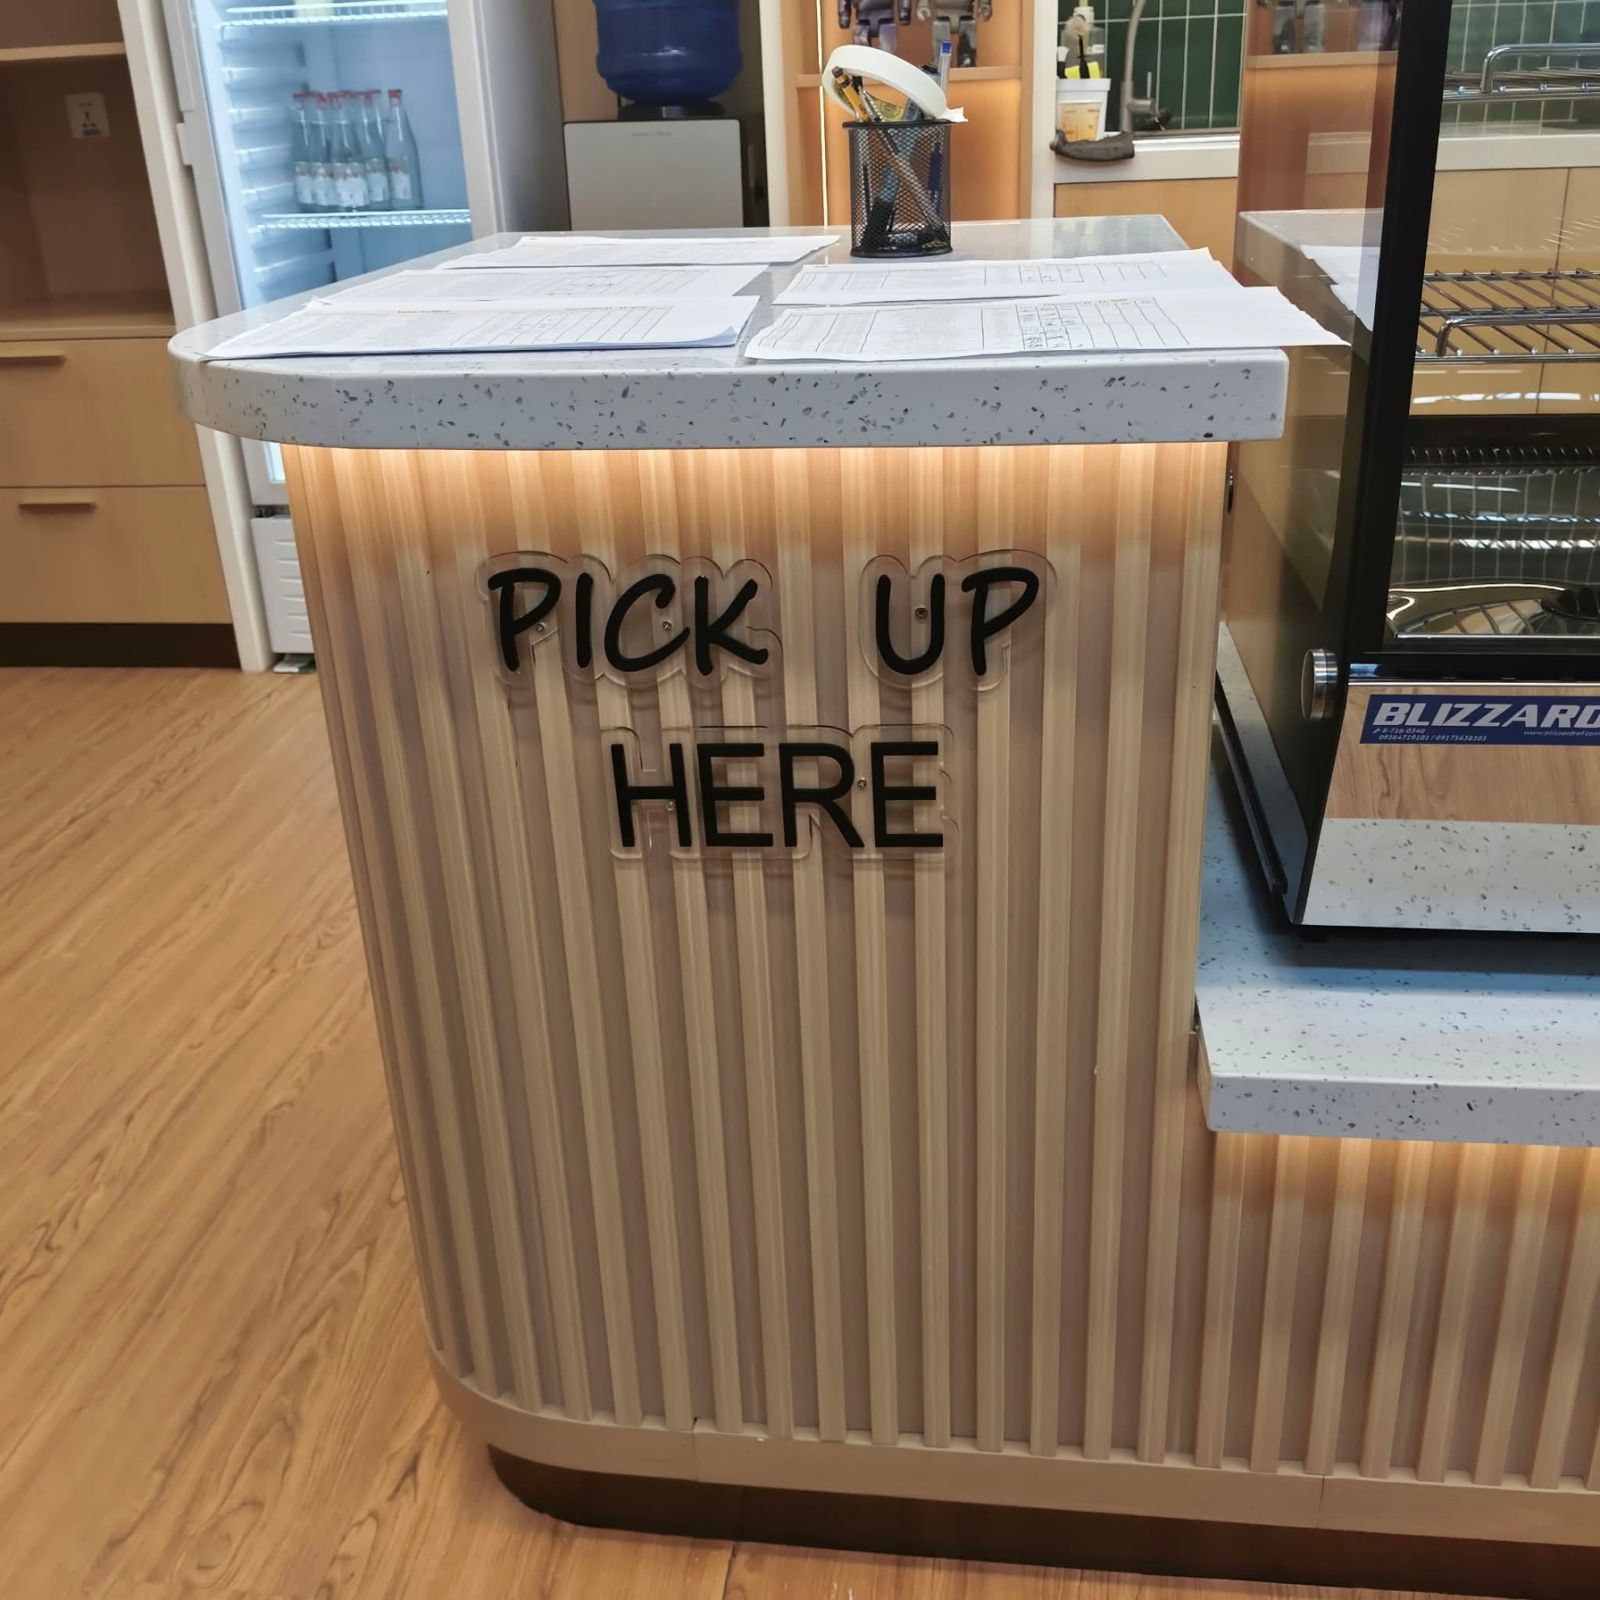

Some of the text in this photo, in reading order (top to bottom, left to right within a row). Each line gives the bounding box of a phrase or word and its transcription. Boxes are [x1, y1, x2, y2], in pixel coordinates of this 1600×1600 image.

[488, 567, 1040, 677] PICK UP
[1372, 702, 1600, 729] BLIZZARD
[610, 740, 945, 848] HERE
